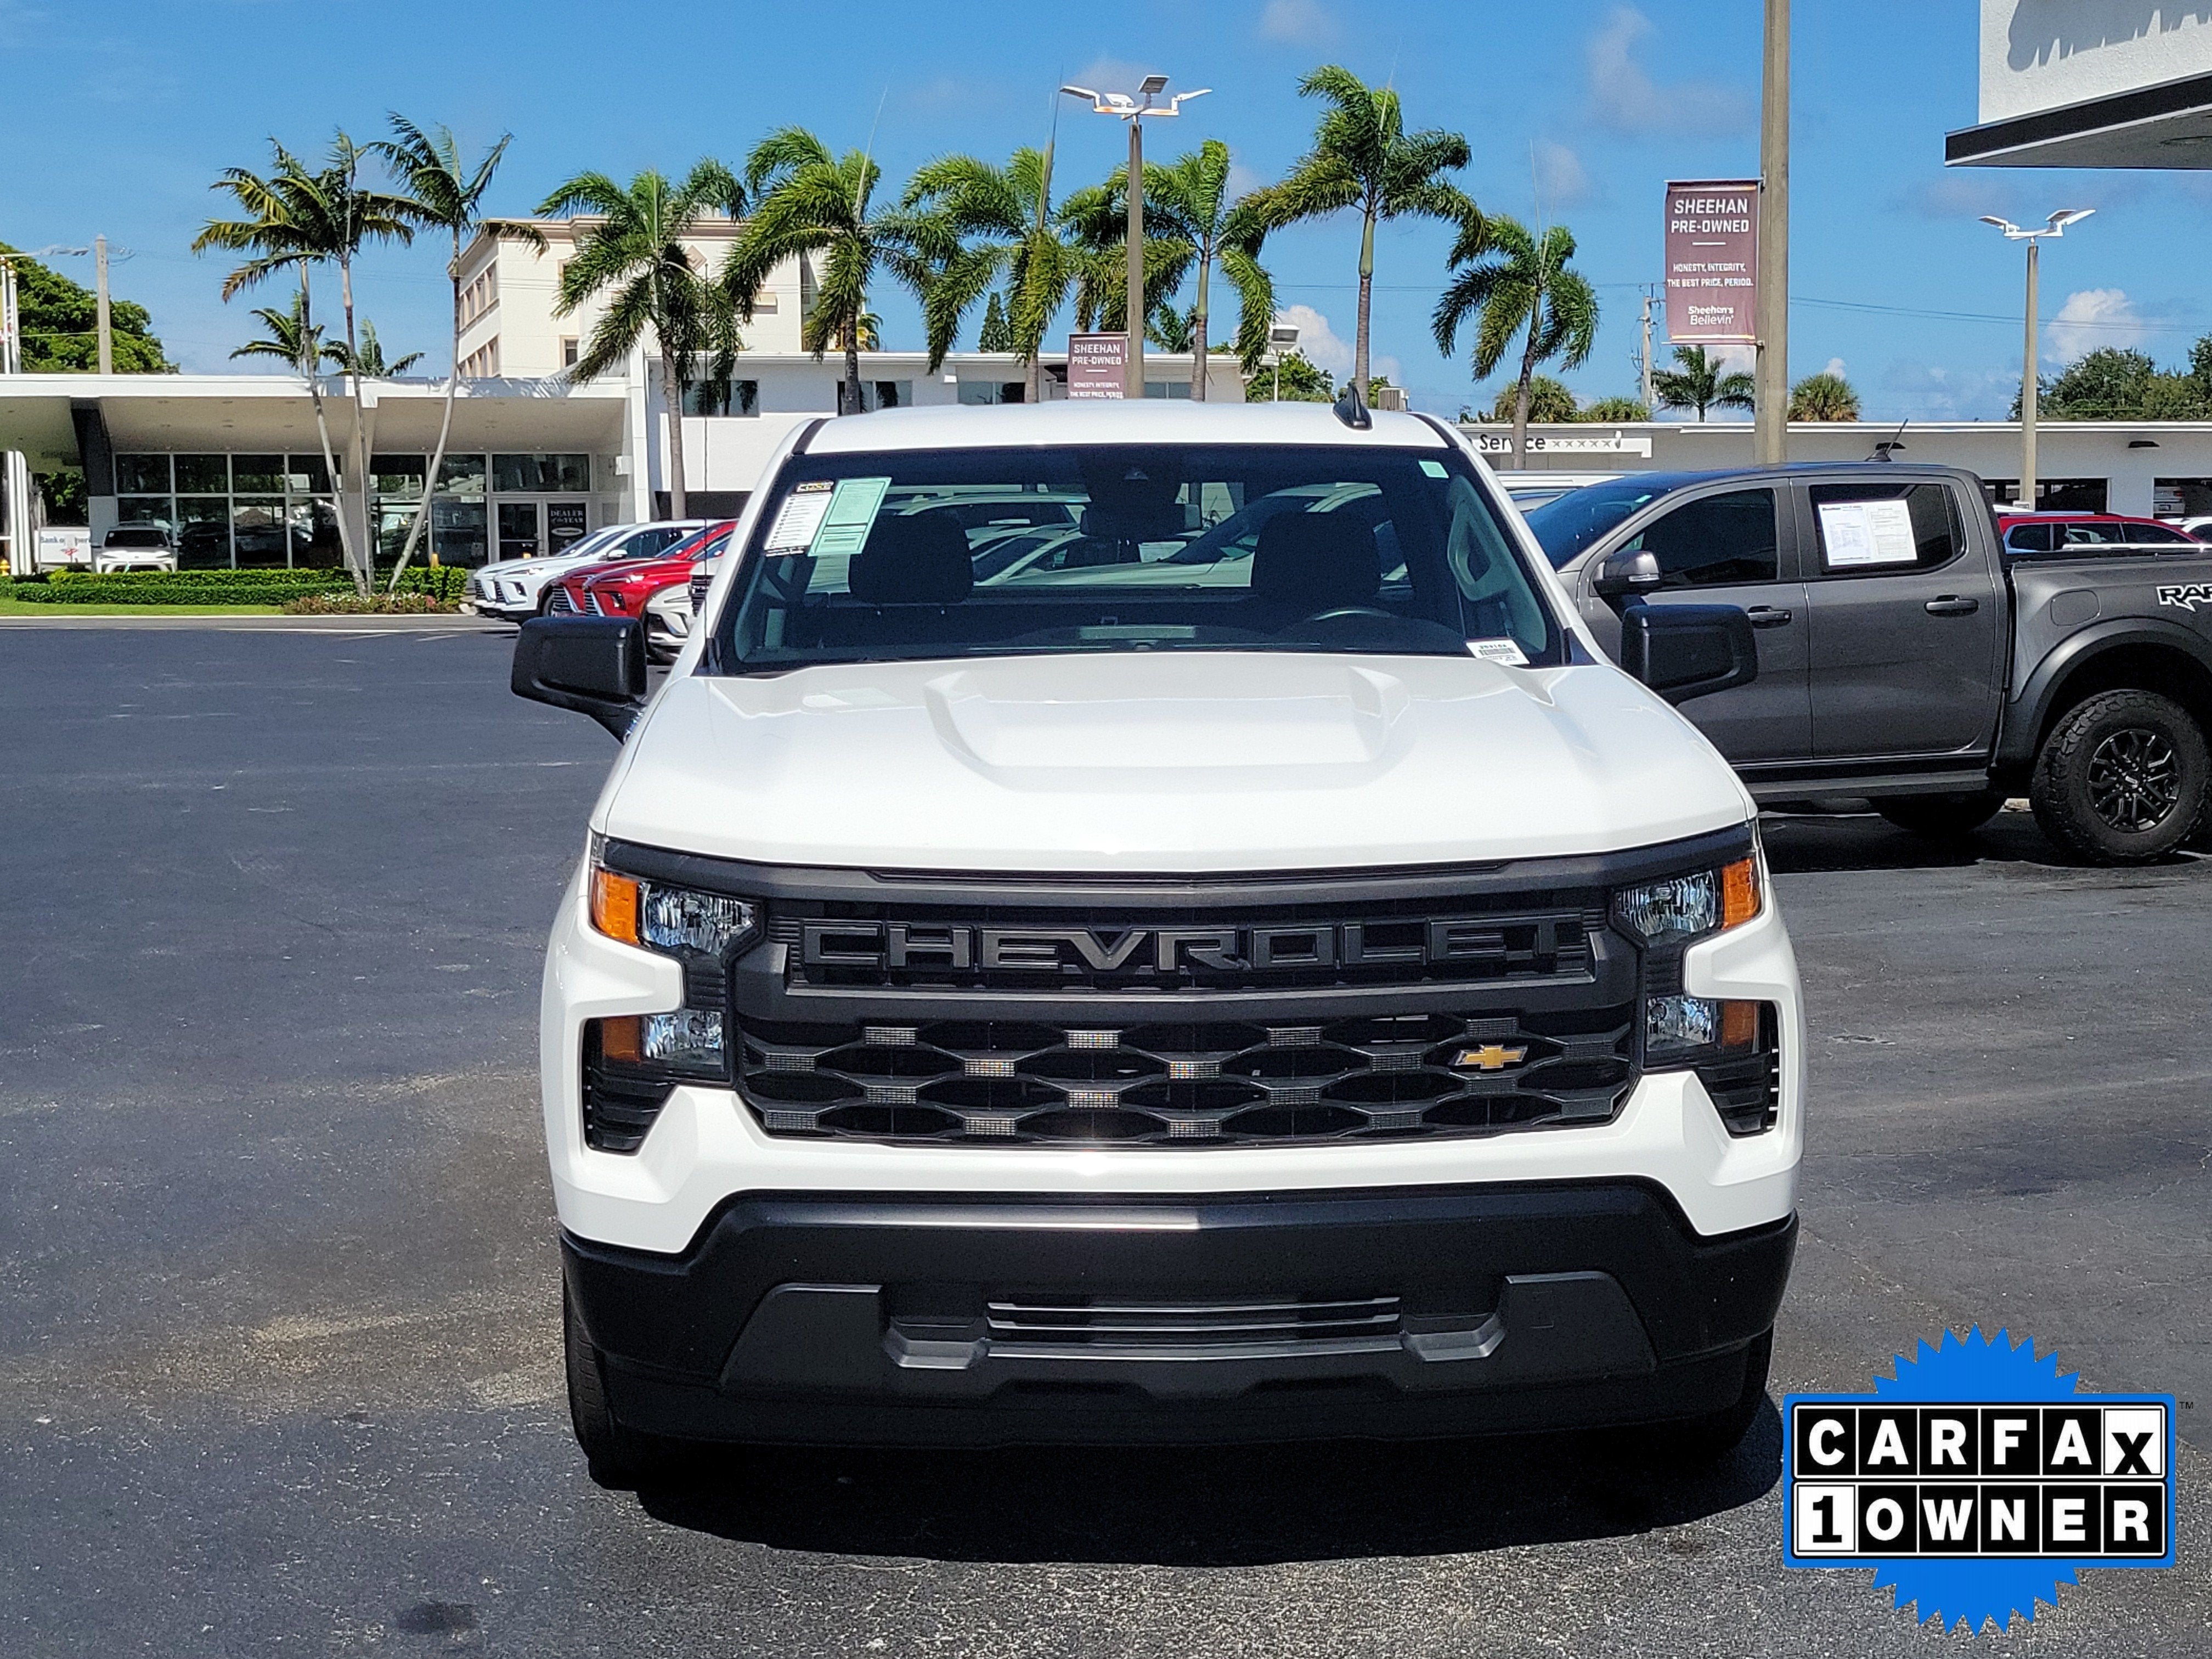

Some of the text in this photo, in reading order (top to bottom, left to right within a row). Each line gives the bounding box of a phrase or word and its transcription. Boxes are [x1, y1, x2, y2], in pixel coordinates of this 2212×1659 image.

[1674, 199, 1748, 214] SHEEHAN
[1671, 219, 1749, 233] PRE-OWNED
[1667, 279, 1680, 287] THE
[1074, 344, 1120, 353] SHEEHAN
[1072, 356, 1122, 365] PRE-OWNED
[1480, 433, 1546, 450] Serce
[803, 913, 1582, 972] CHEVROLET
